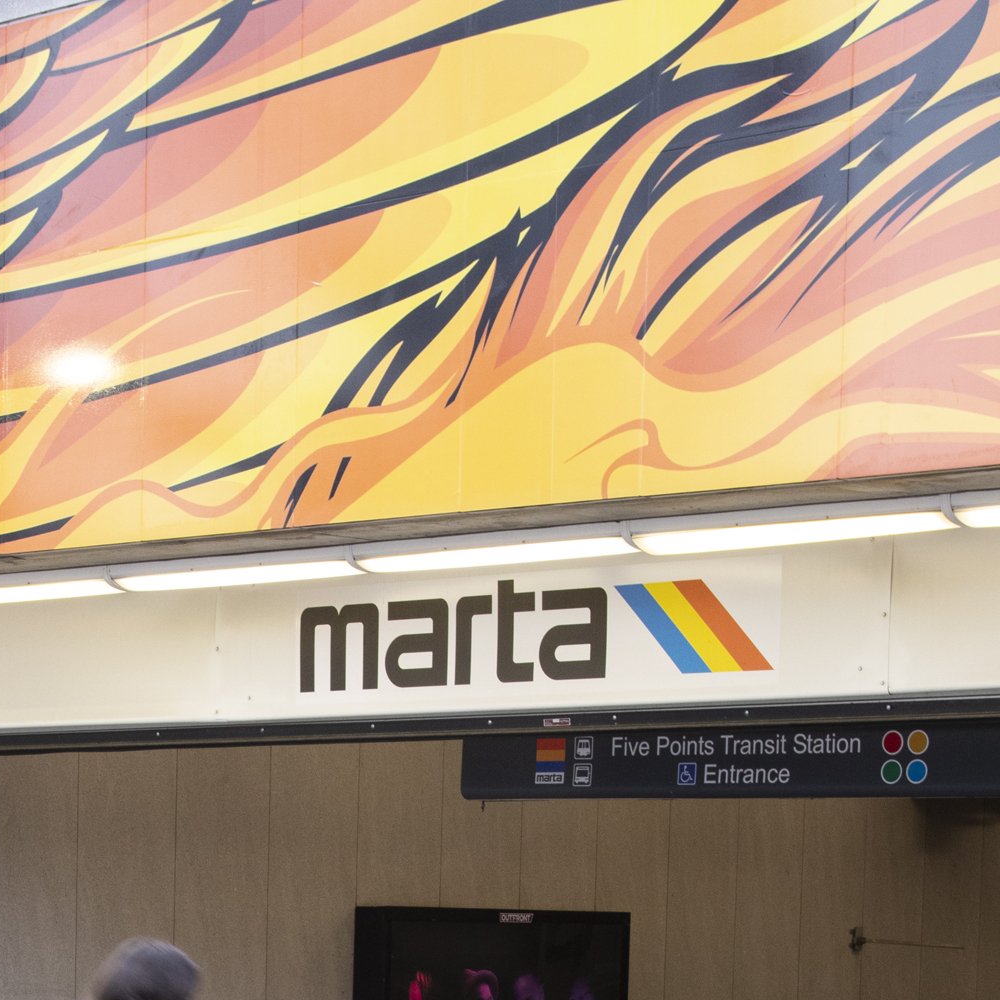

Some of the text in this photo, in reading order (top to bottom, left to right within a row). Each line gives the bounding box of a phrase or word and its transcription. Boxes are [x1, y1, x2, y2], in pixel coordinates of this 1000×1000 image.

[300, 579, 608, 692] marta
[611, 733, 862, 756] Five Points Transit Station
[536, 773, 563, 783] marta
[703, 764, 791, 784] Entrance
[501, 914, 532, 922] OUTFRONT
